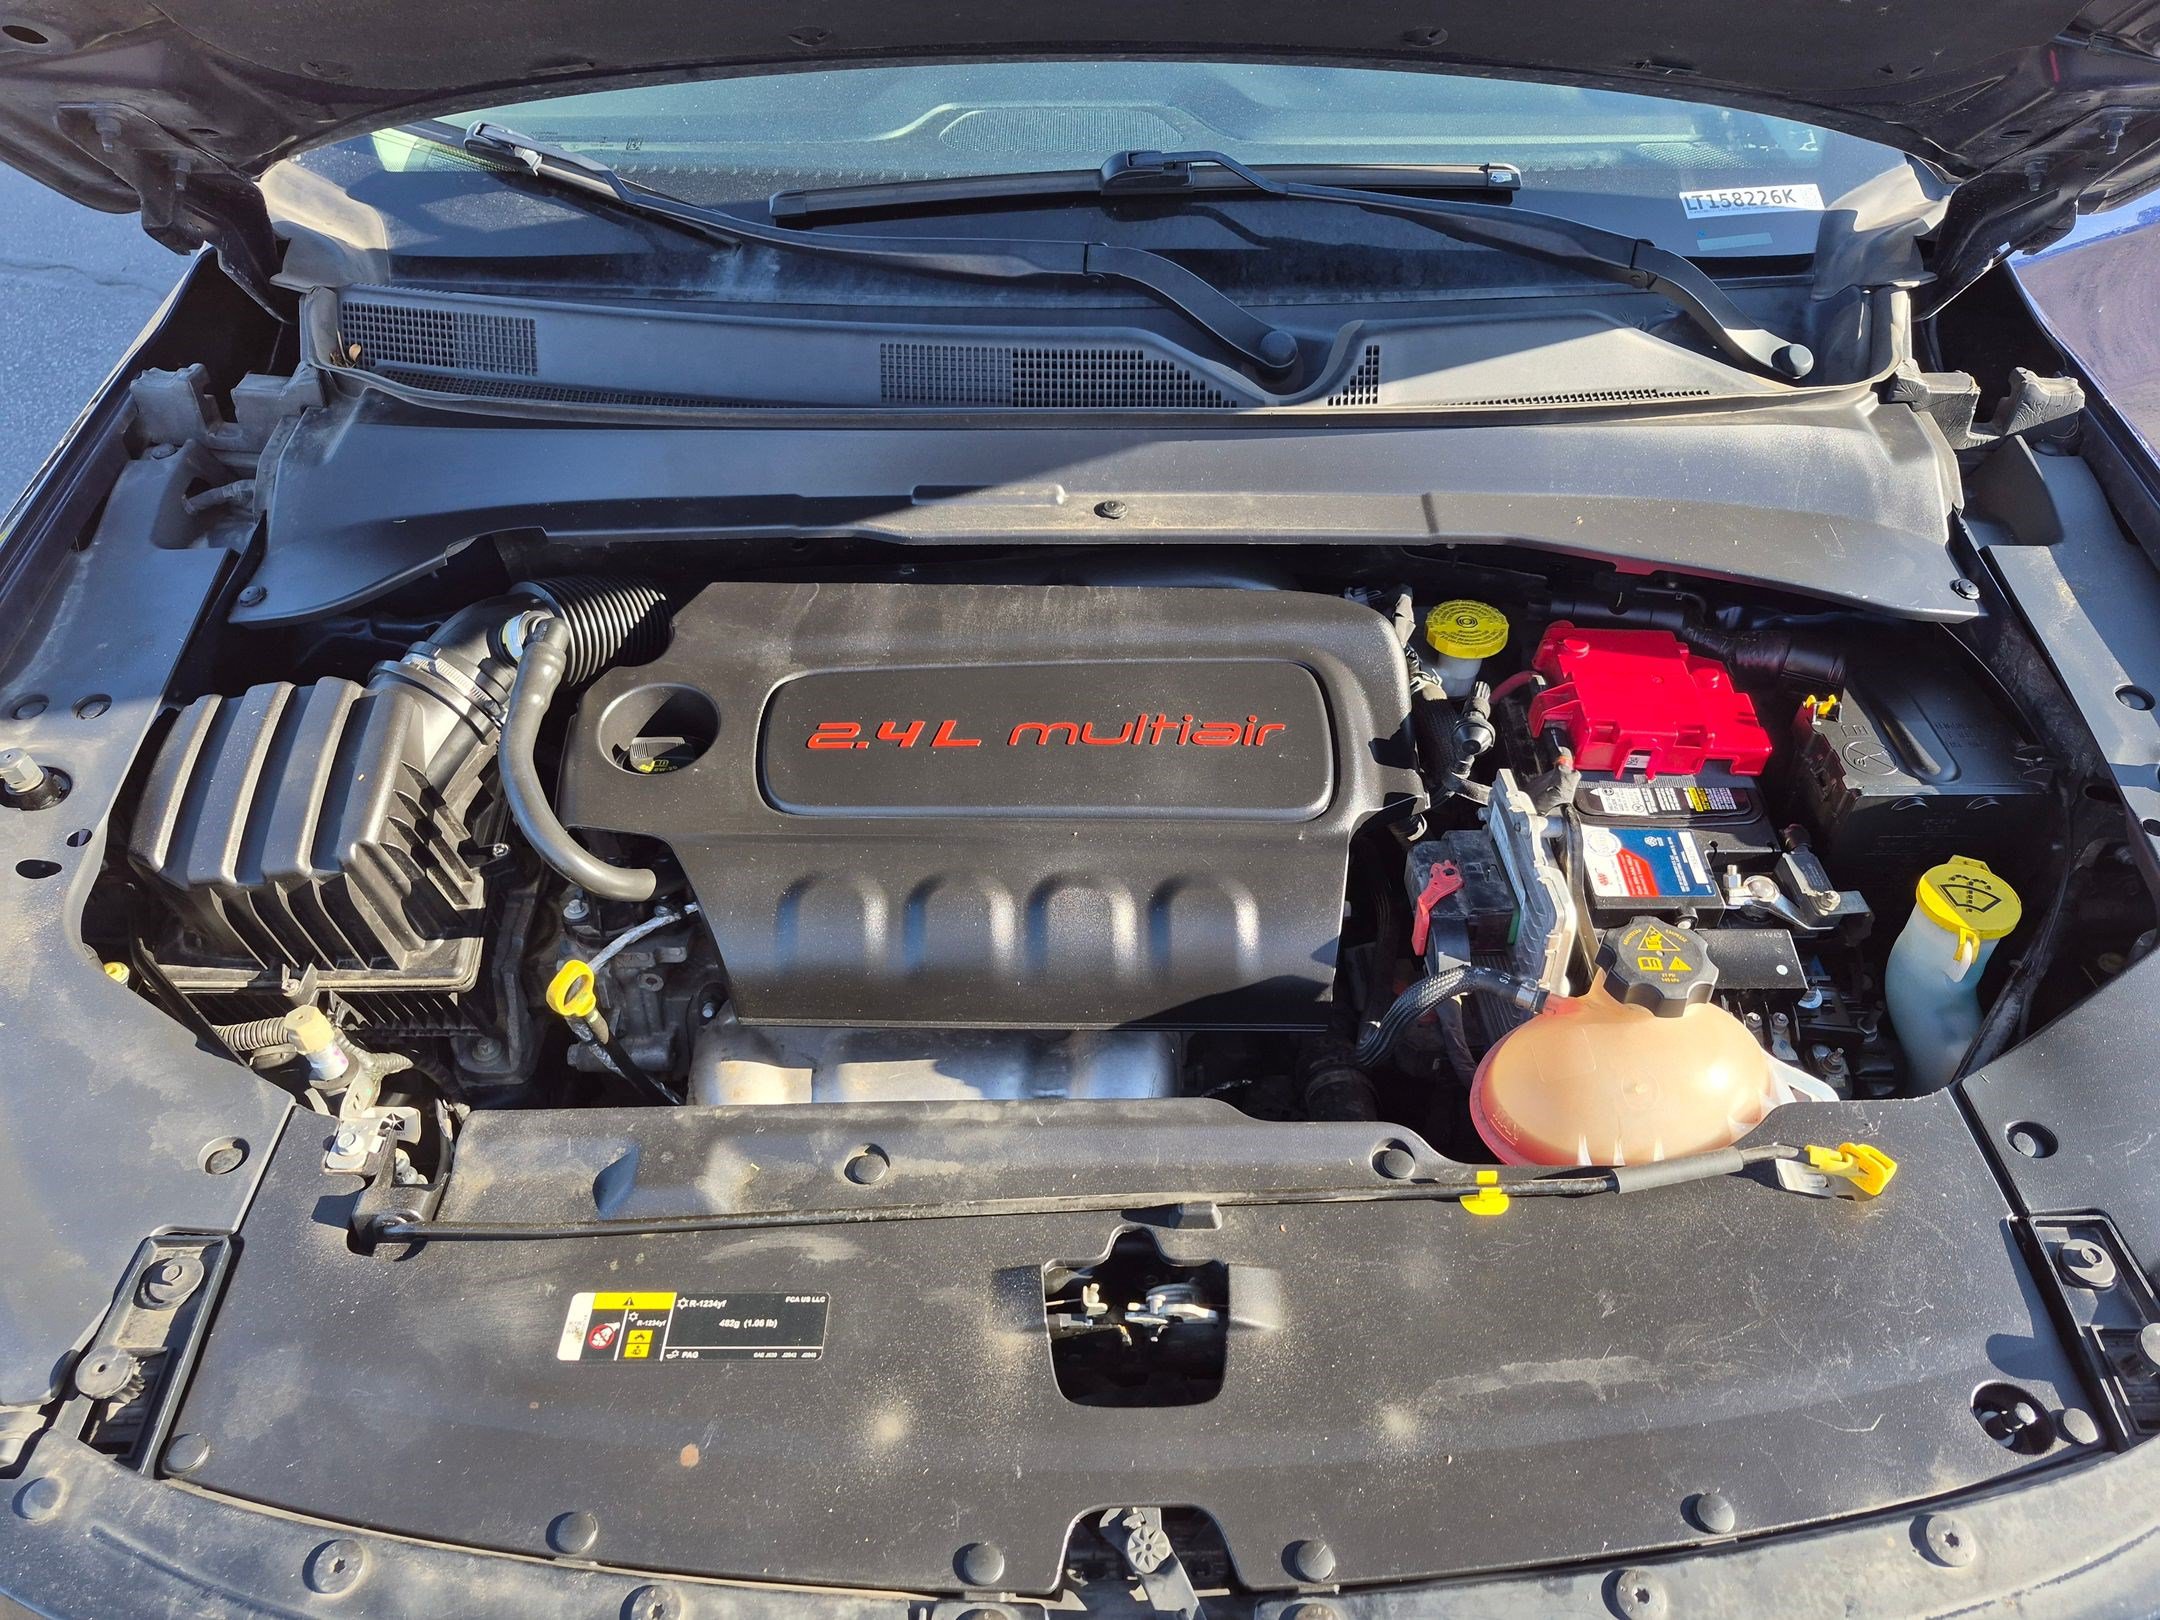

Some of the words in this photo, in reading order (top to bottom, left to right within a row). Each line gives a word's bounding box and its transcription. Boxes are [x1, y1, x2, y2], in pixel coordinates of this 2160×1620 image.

[1683, 188, 1797, 211] LT158226K
[1007, 713, 1286, 747] multiair
[689, 1299, 727, 1309] R-1234yf
[637, 1319, 667, 1328] R-1234yf
[681, 1351, 699, 1359] PAG
